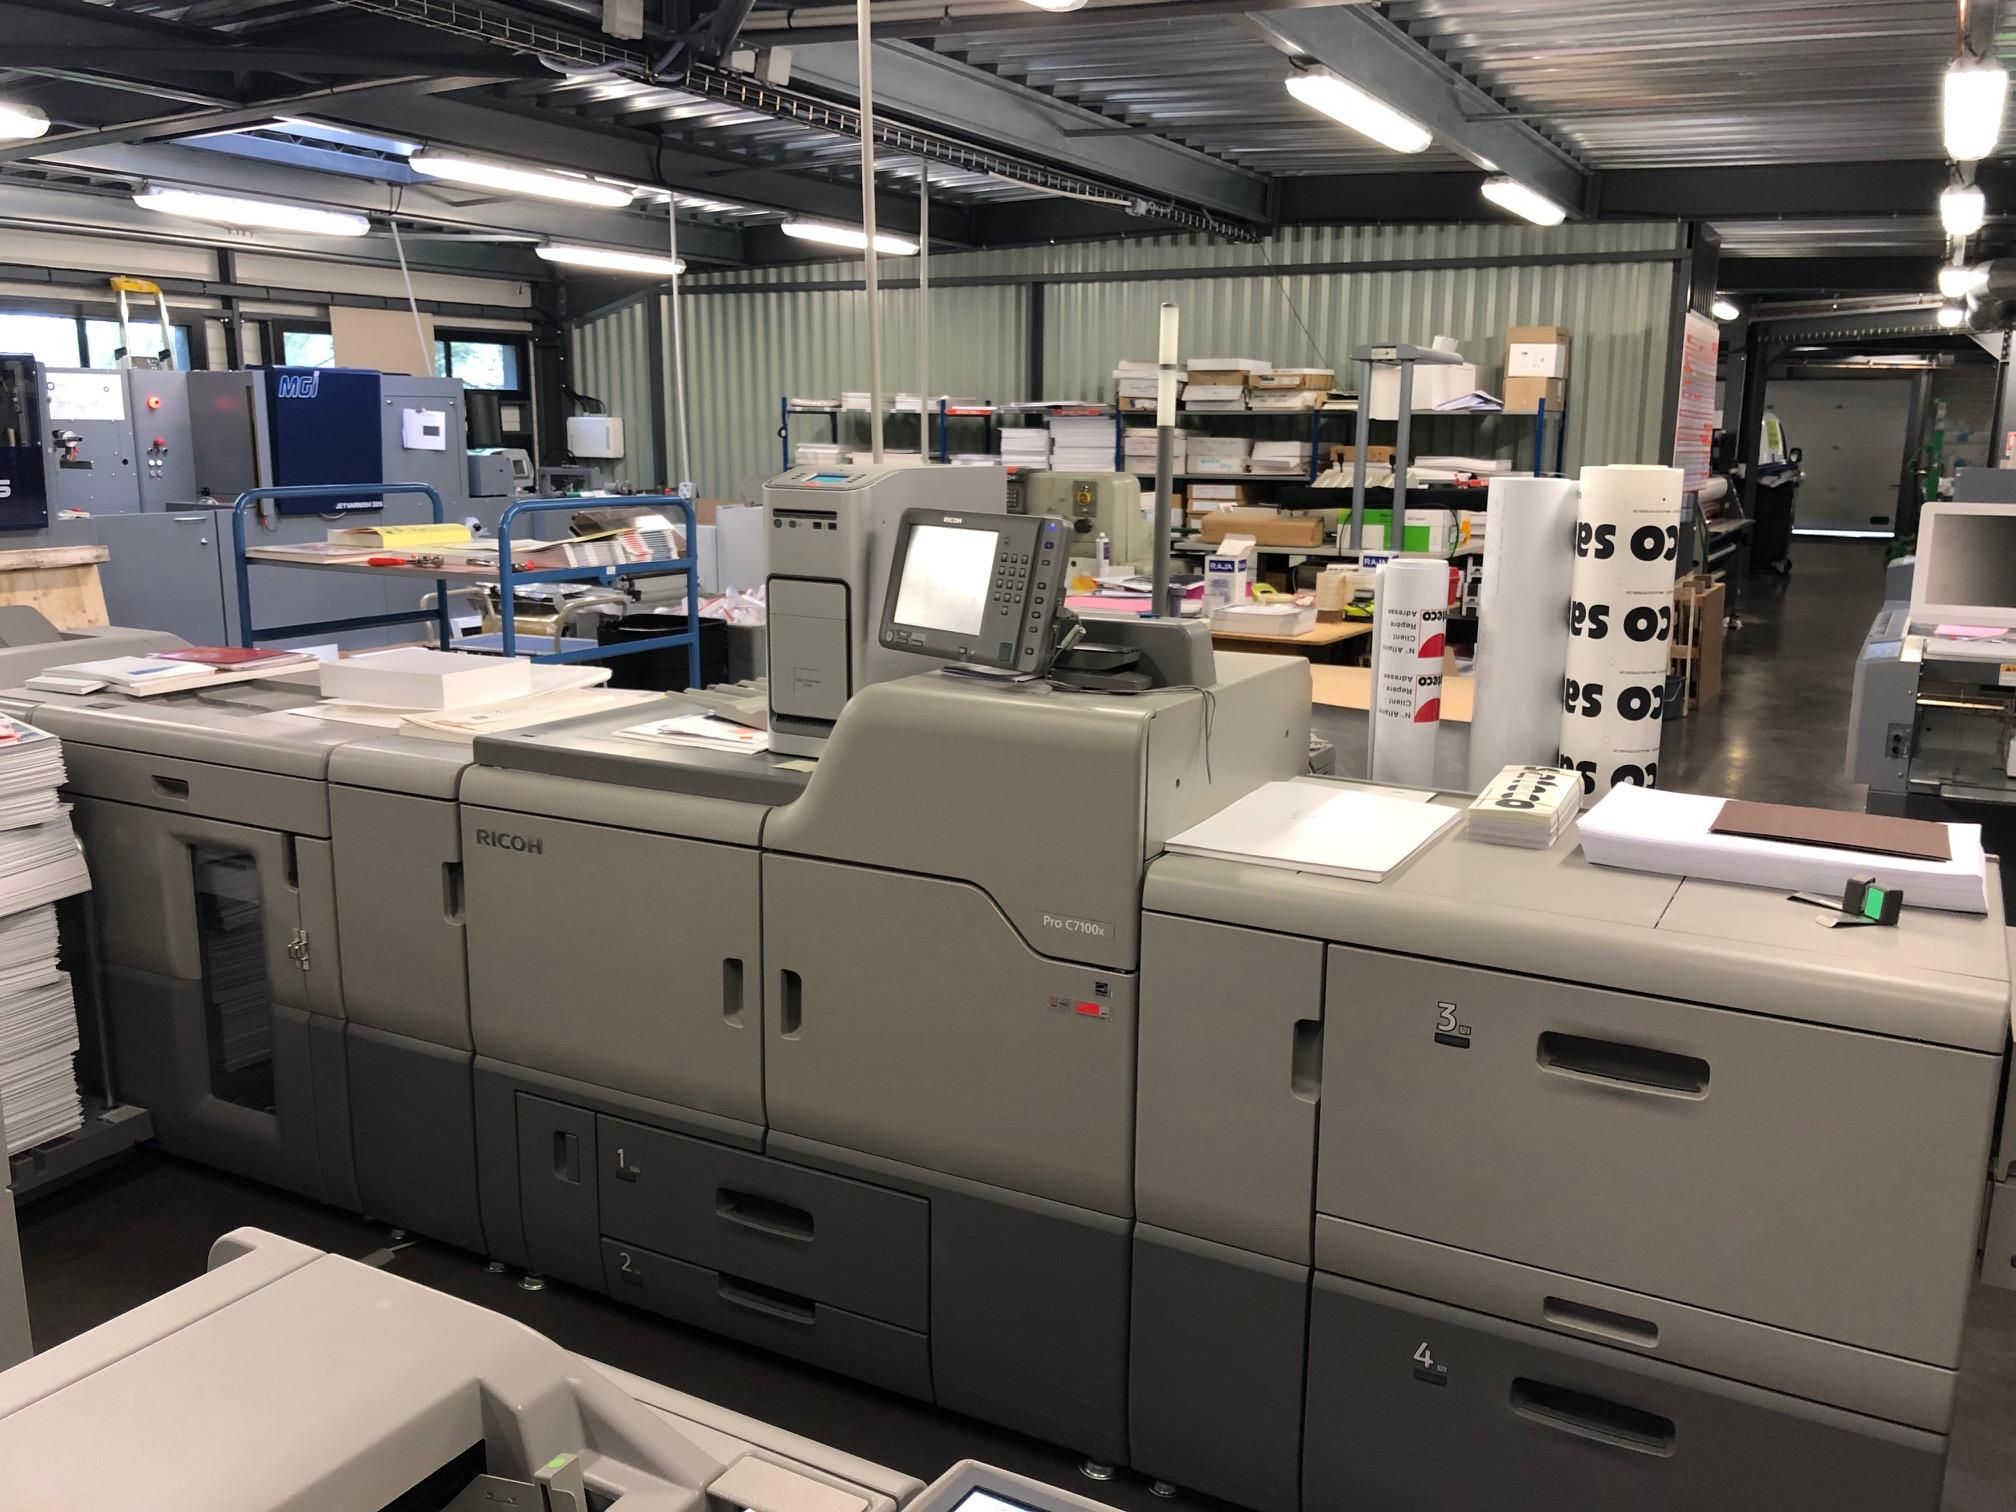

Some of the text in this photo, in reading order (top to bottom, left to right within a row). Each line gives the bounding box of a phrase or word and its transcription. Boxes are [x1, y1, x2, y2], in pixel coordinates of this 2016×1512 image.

[1209, 561, 1235, 572] RAJA
[476, 829, 544, 855] RICOH
[1043, 915, 1105, 936] Pro C7100x
[1436, 1001, 1457, 1032] 3
[616, 1148, 625, 1169] 1
[619, 1252, 633, 1272] 2
[1413, 1341, 1434, 1369] 4
